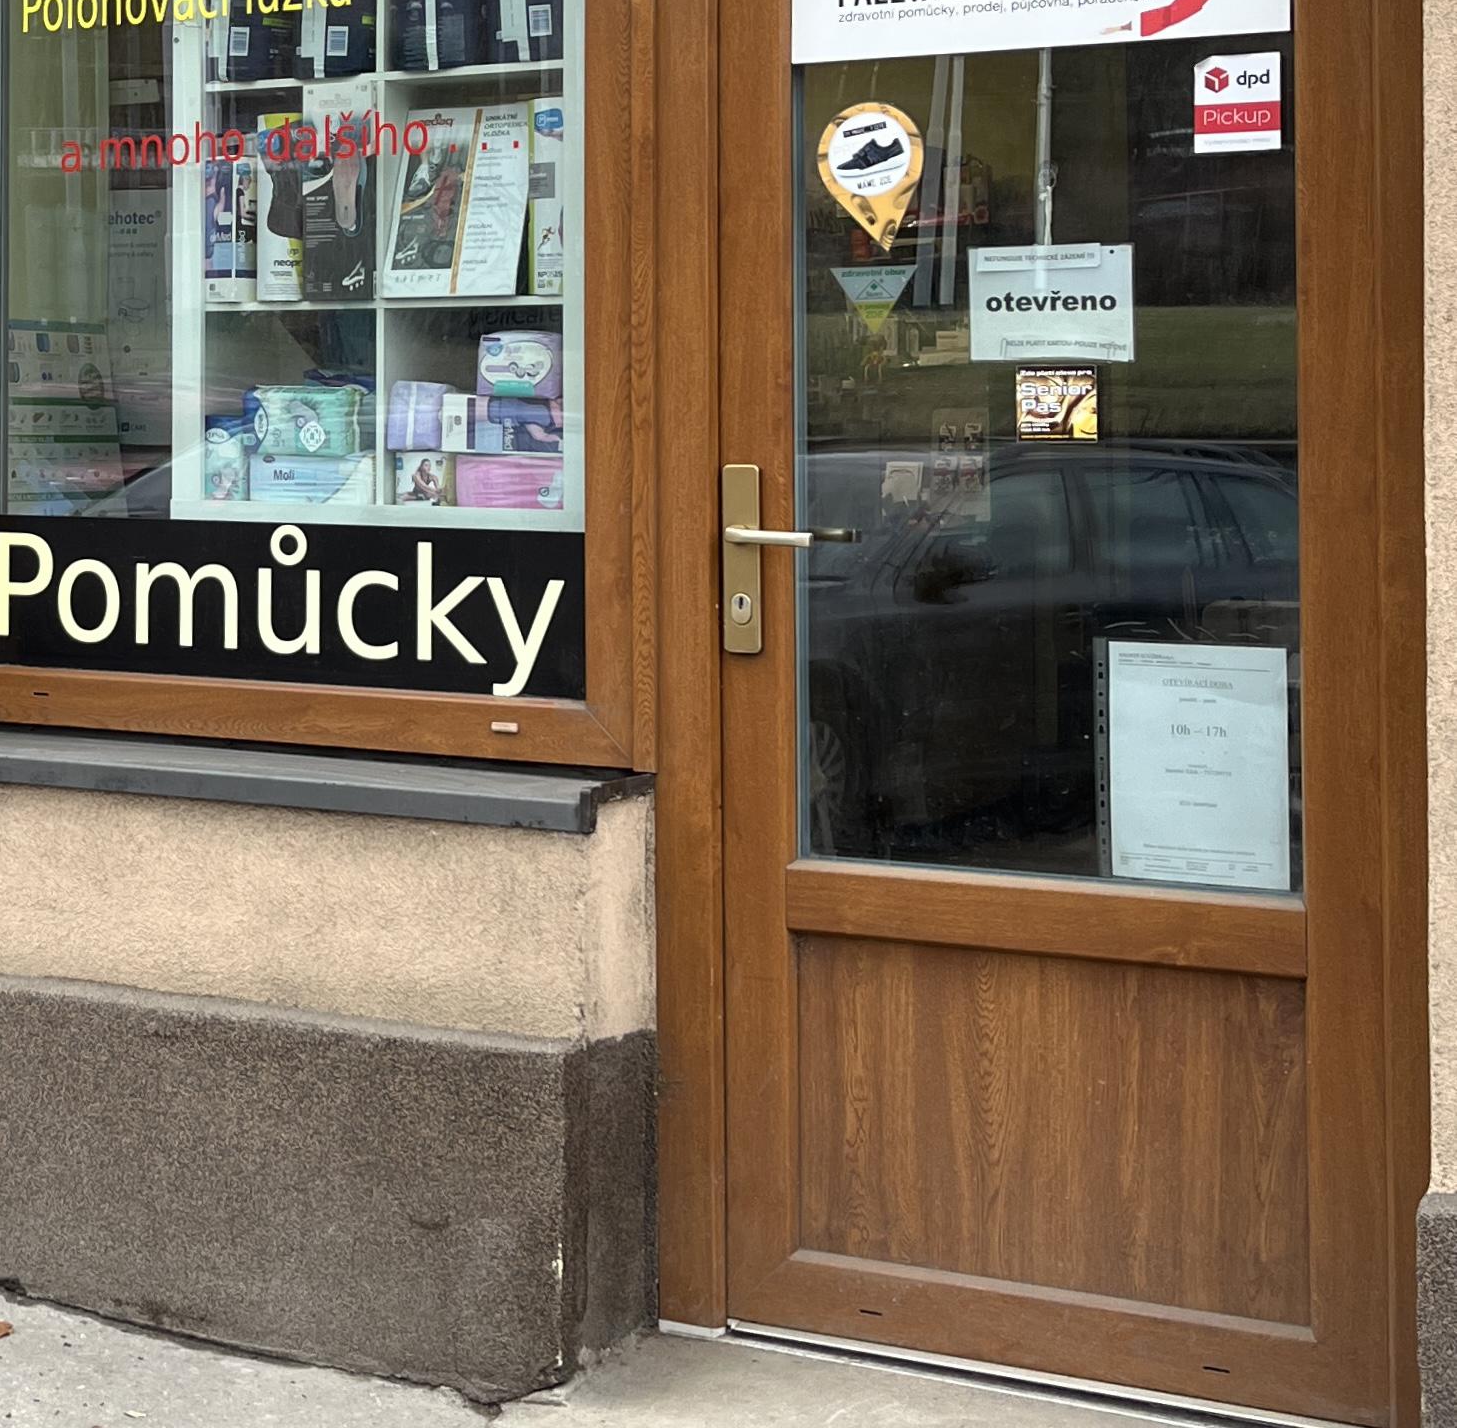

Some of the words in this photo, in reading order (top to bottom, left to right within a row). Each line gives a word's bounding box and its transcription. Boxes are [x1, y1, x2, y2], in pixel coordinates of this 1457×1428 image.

[838, 7, 895, 23] zdravotní
[898, 4, 959, 20] pomůcky,
[963, 0, 1007, 16] prodej,
[1236, 68, 1270, 89] dpd
[1203, 107, 1271, 127] Pickup
[61, 140, 83, 173] a
[99, 120, 244, 173] mnoho
[266, 108, 430, 163] dalšího
[985, 290, 1117, 313] otevřeno
[1021, 381, 1093, 396] Senior
[1021, 398, 1062, 413] Pas
[1170, 723, 1191, 736] 10h
[1206, 725, 1227, 738] 17h
